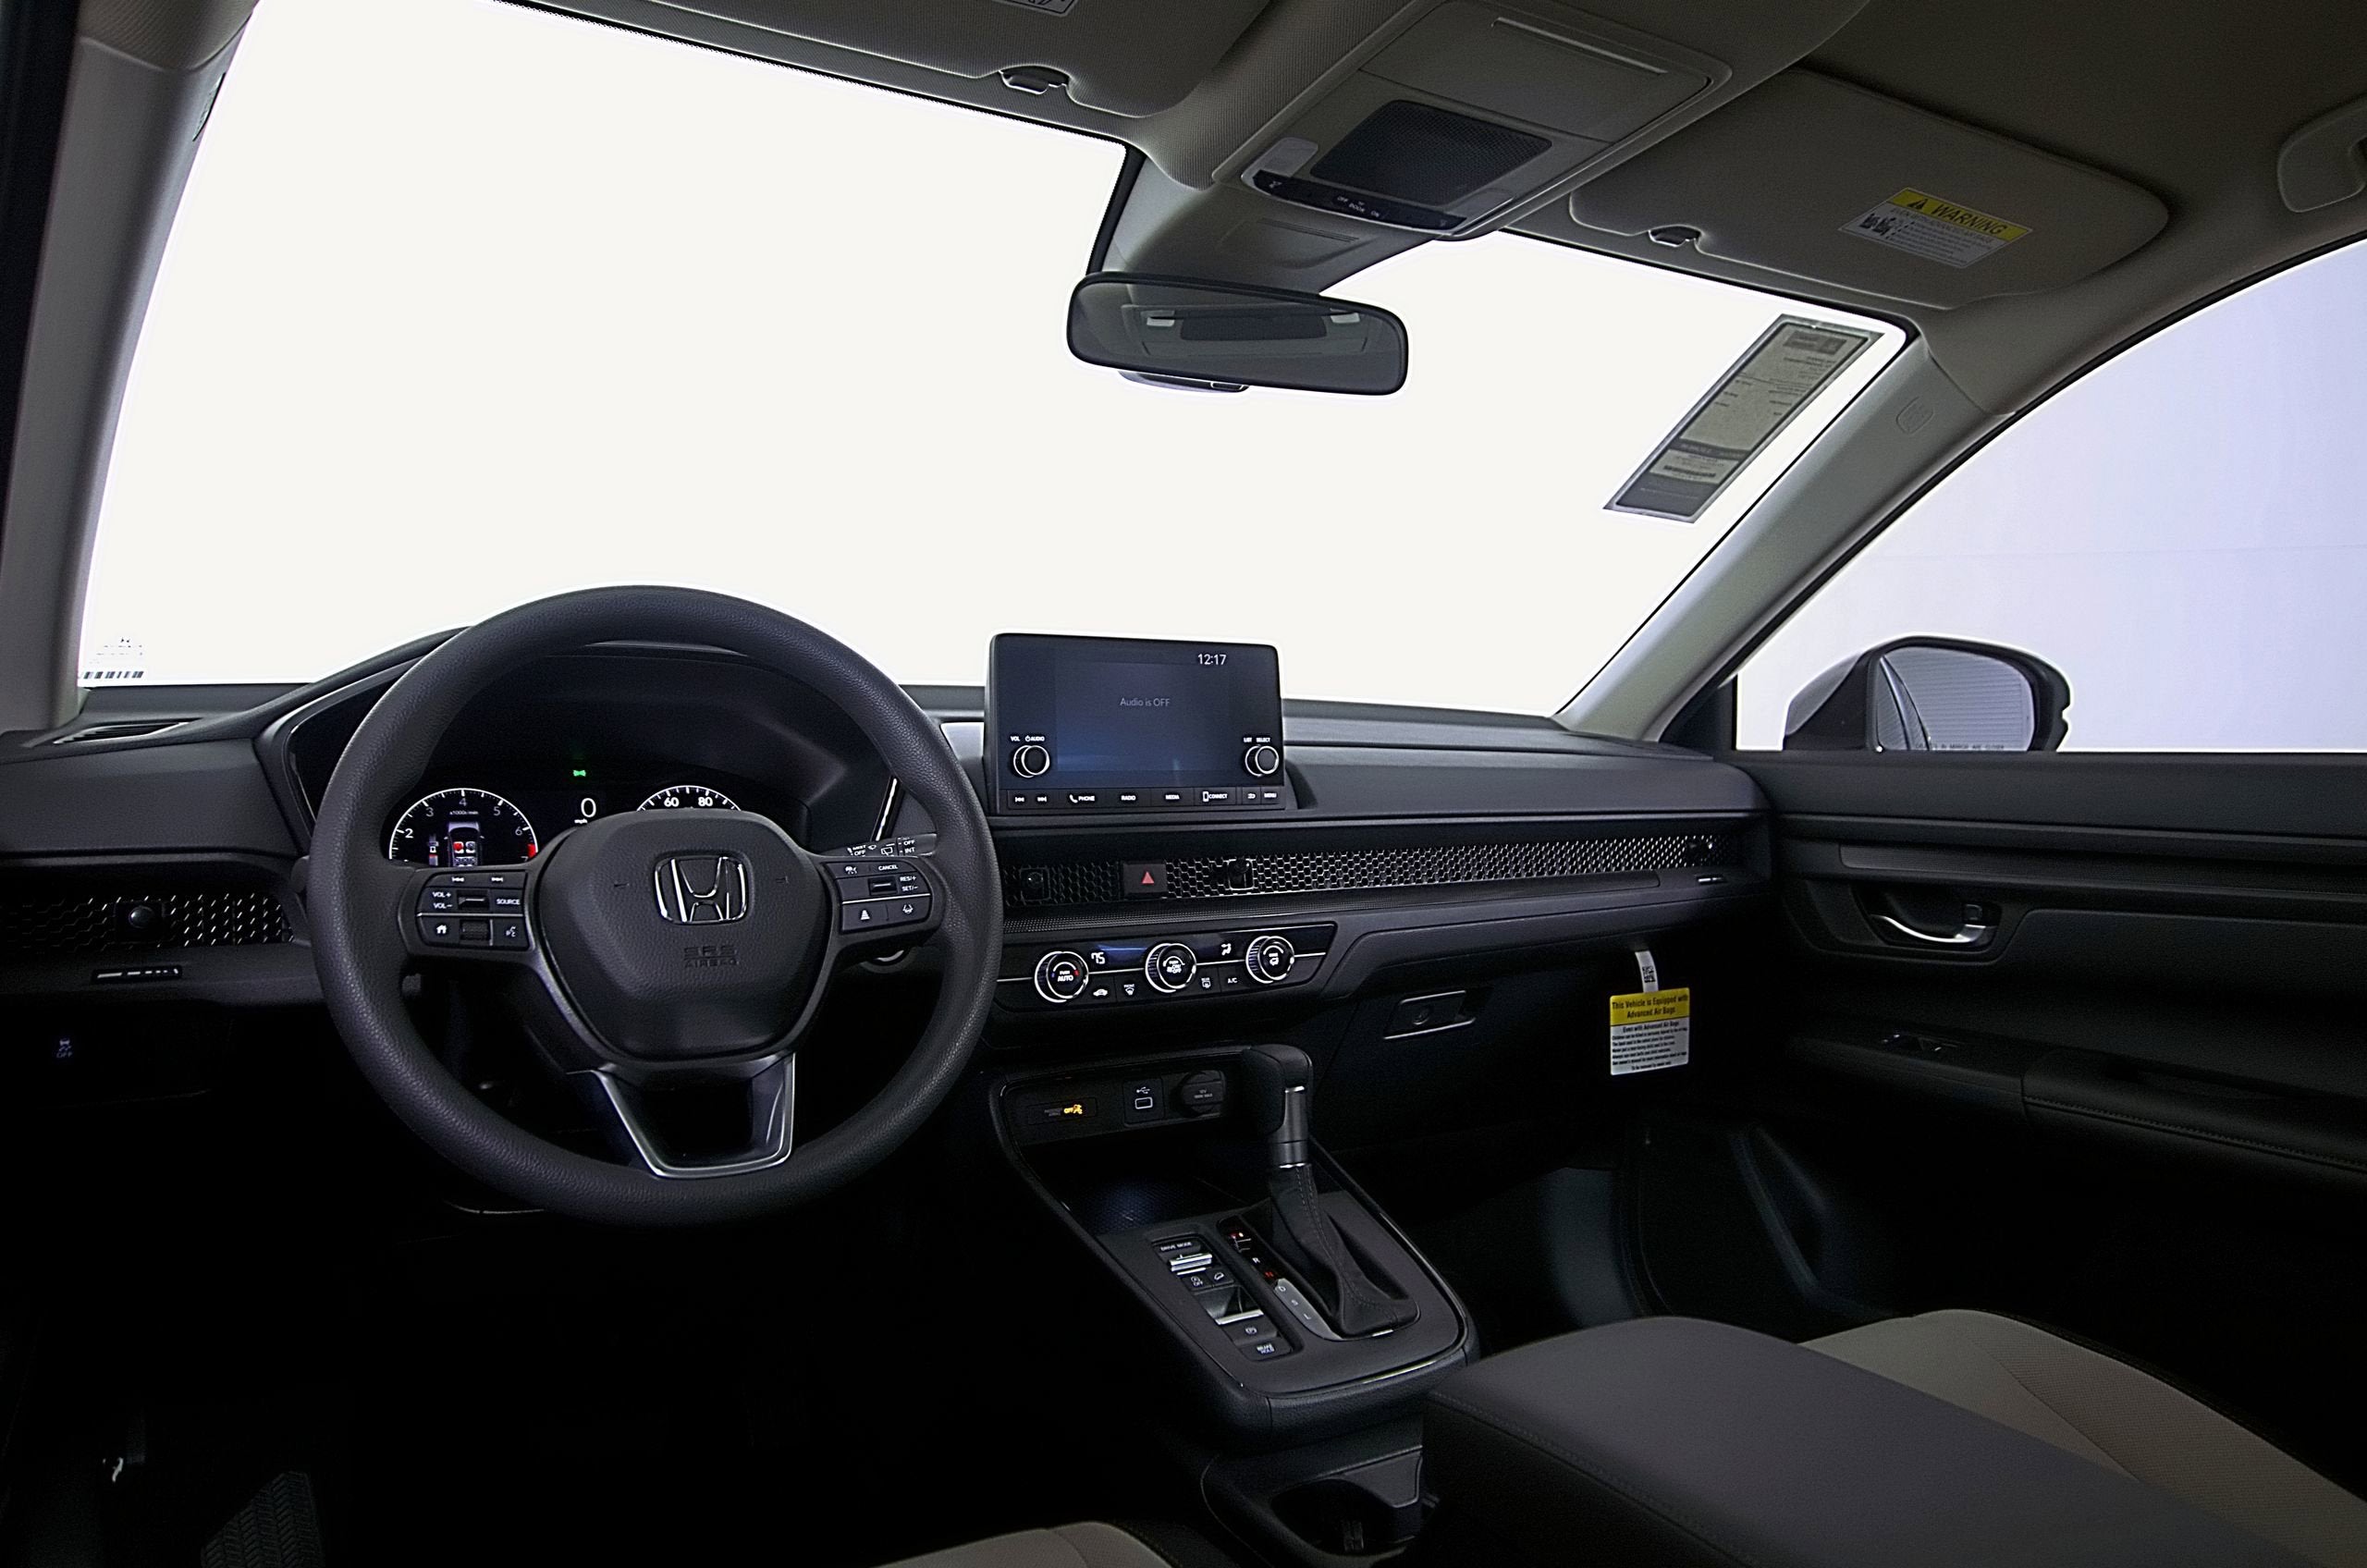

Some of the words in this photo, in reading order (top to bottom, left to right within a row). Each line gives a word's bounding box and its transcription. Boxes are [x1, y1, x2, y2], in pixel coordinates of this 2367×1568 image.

[1931, 203, 2007, 234] WARNING
[1197, 653, 1227, 666] 12:17
[1120, 697, 1144, 706] Audio
[1145, 697, 1152, 706] is
[1153, 697, 1171, 706] OFF
[459, 798, 467, 806] 4
[664, 797, 680, 807] 60
[698, 797, 713, 807] 80
[425, 807, 434, 816] 3
[493, 806, 501, 815] 5
[581, 798, 596, 817] 0
[404, 827, 413, 839] 2
[515, 826, 522, 836] 6
[1091, 952, 1106, 964] 75
[1612, 1001, 1625, 1010] This
[1625, 998, 1646, 1009] Vehicle
[1652, 996, 1676, 1007] Equipped
[1627, 1009, 1653, 1018] Advanced
